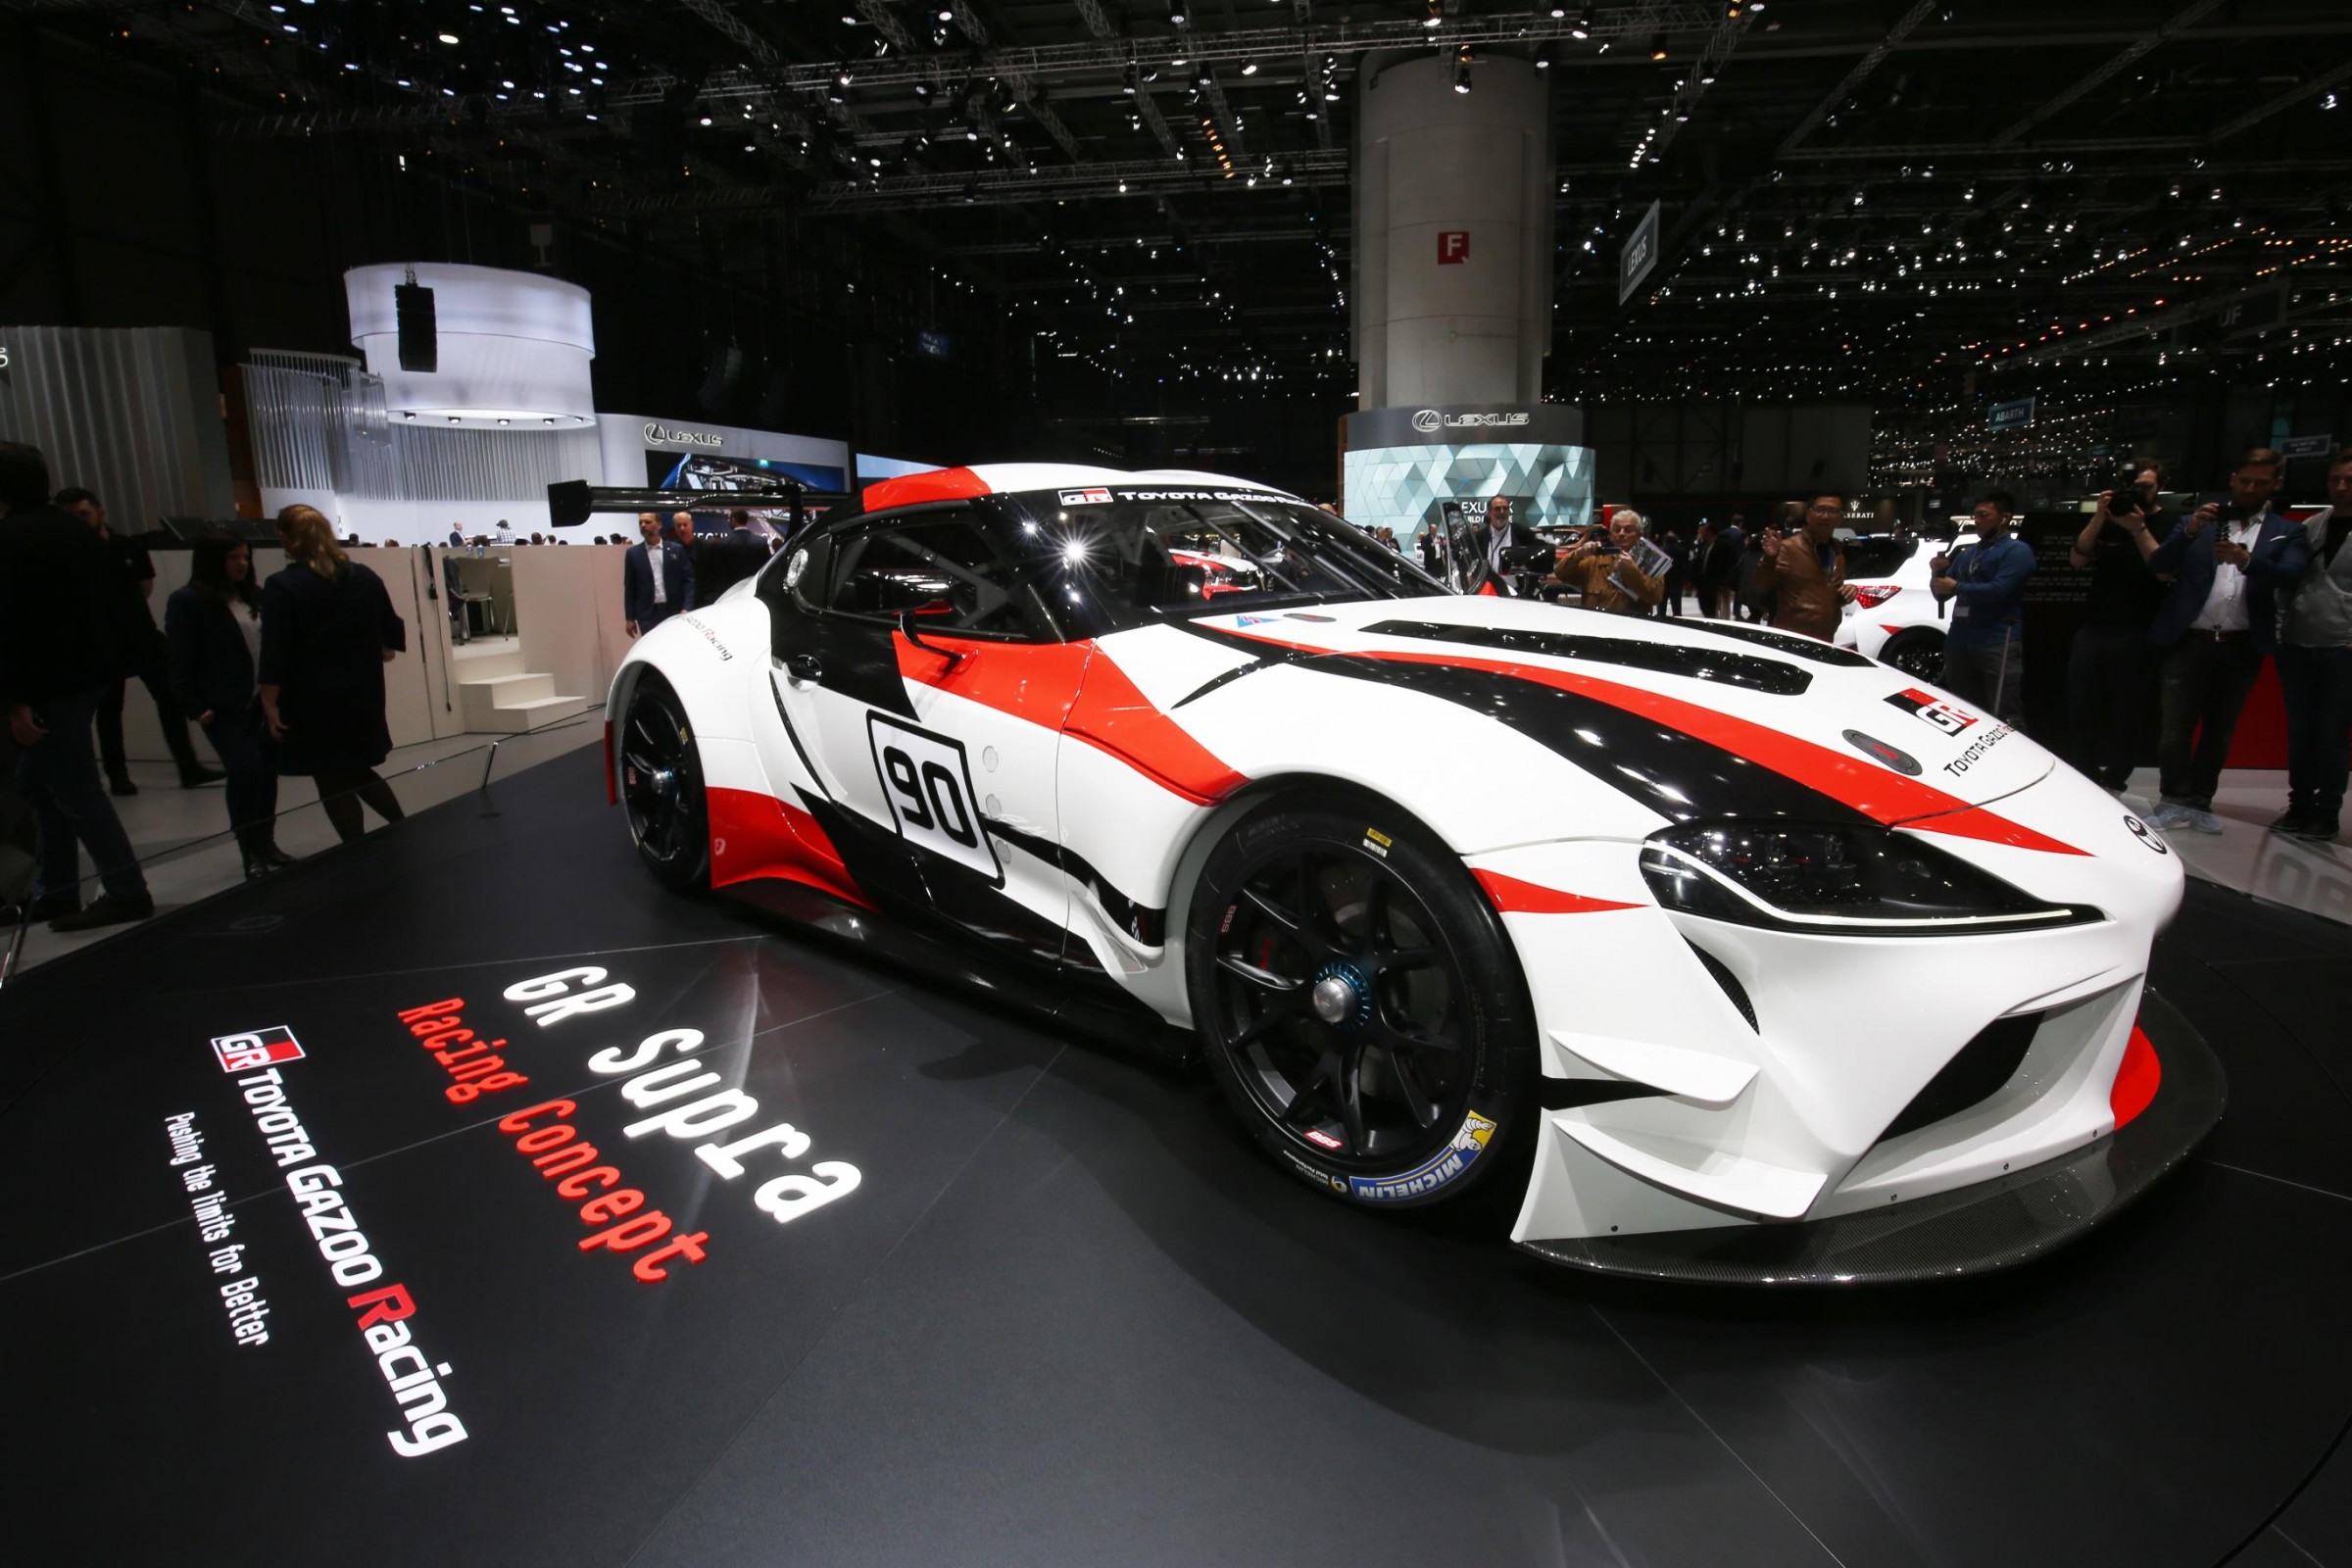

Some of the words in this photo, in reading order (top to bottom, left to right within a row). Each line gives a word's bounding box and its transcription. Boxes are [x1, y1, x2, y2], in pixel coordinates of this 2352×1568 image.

[1446, 234, 1463, 257] F
[1627, 235, 1647, 277] LEXUS
[666, 429, 723, 447] LEXUS
[1444, 413, 1530, 427] LEXUS
[1117, 491, 1213, 501] TOYOTA
[1461, 501, 1489, 514] EXU
[1943, 742, 1988, 777] TOYOTA
[883, 746, 978, 849] 90
[504, 965, 637, 1028] GR
[588, 1028, 862, 1225] Supra
[165, 1111, 205, 1166] Pushing
[397, 997, 530, 1105] Racing
[498, 1098, 710, 1284] Concept
[1306, 1131, 1343, 1148] BBS
[182, 1163, 217, 1193] the
[1358, 1153, 1464, 1199] MICHELIN
[191, 1190, 236, 1243] limits
[209, 1244, 246, 1274] for
[238, 1068, 317, 1167] TOYOTA
[285, 1164, 383, 1287] GAZOO
[347, 1283, 468, 1457] Racing
[220, 1276, 270, 1346] Better
